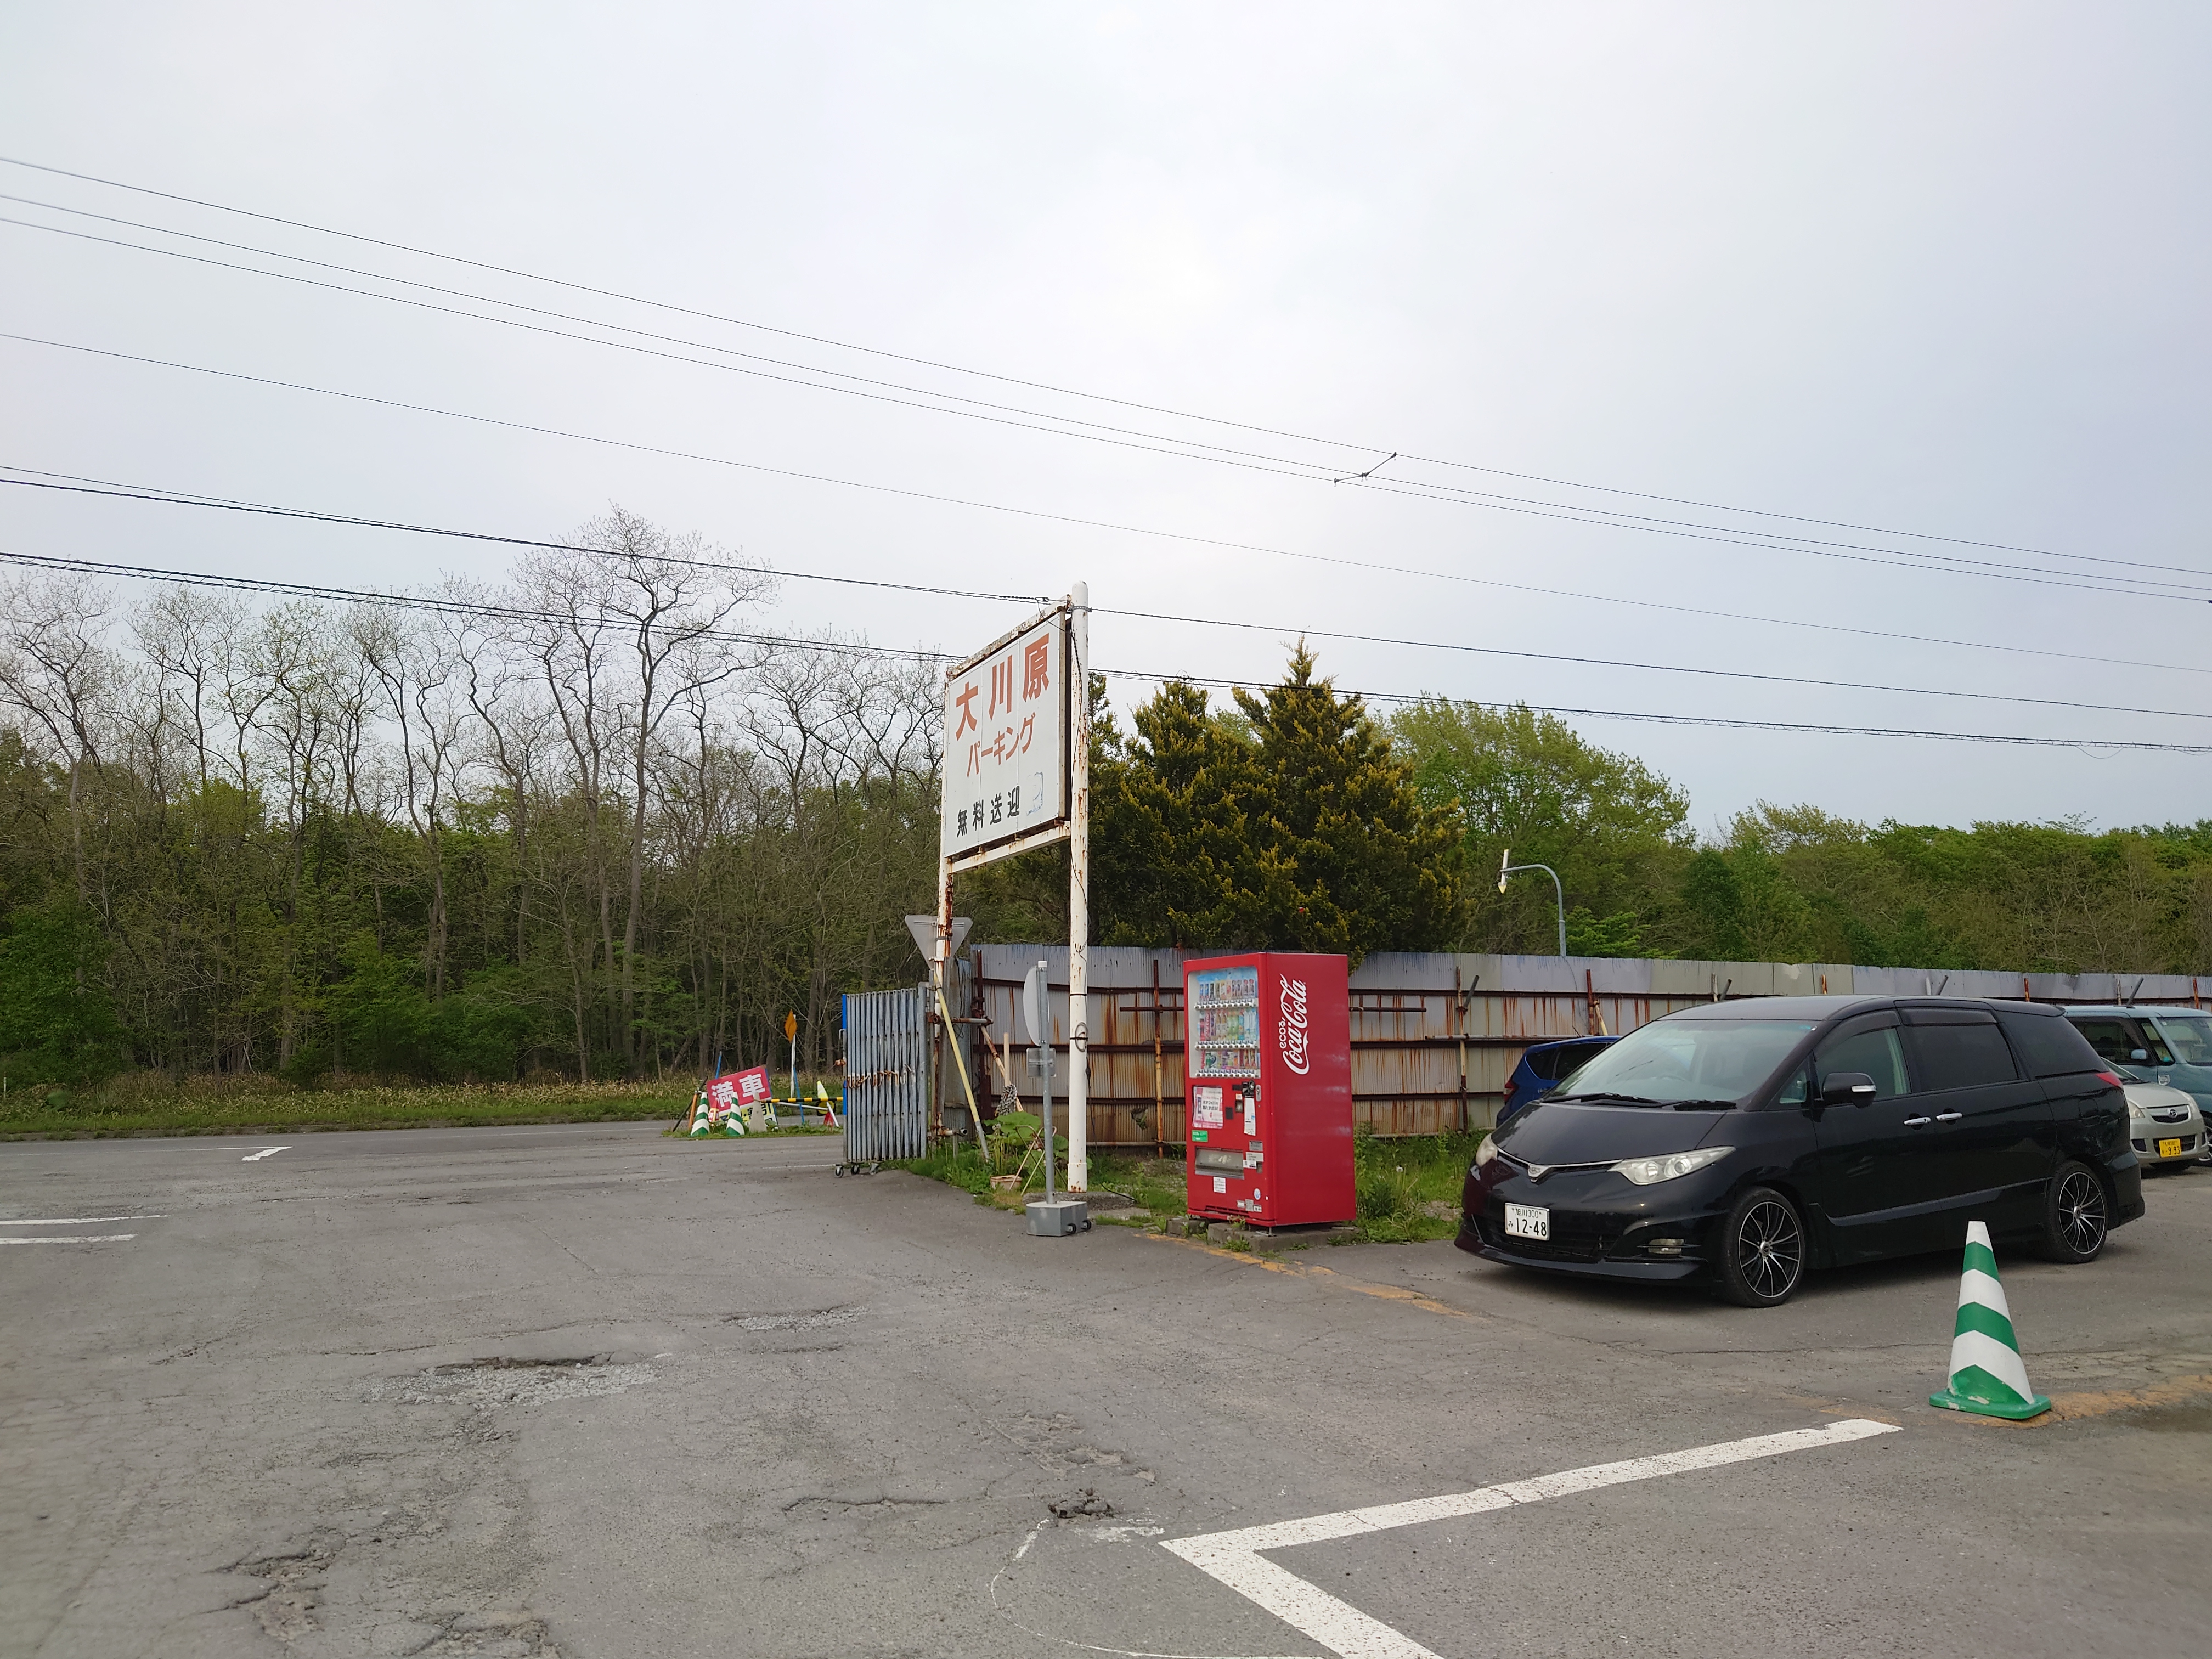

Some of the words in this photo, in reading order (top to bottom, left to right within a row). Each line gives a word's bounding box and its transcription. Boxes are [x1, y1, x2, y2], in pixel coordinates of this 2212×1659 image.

[955, 633, 1049, 741] 大川原
[967, 712, 1036, 778] パーキング
[956, 785, 1020, 838] 無料送迎
[1280, 973, 1310, 1075] Coca-Cola
[711, 1073, 765, 1107] 満車
[1516, 1217, 1547, 1237] 12-48
